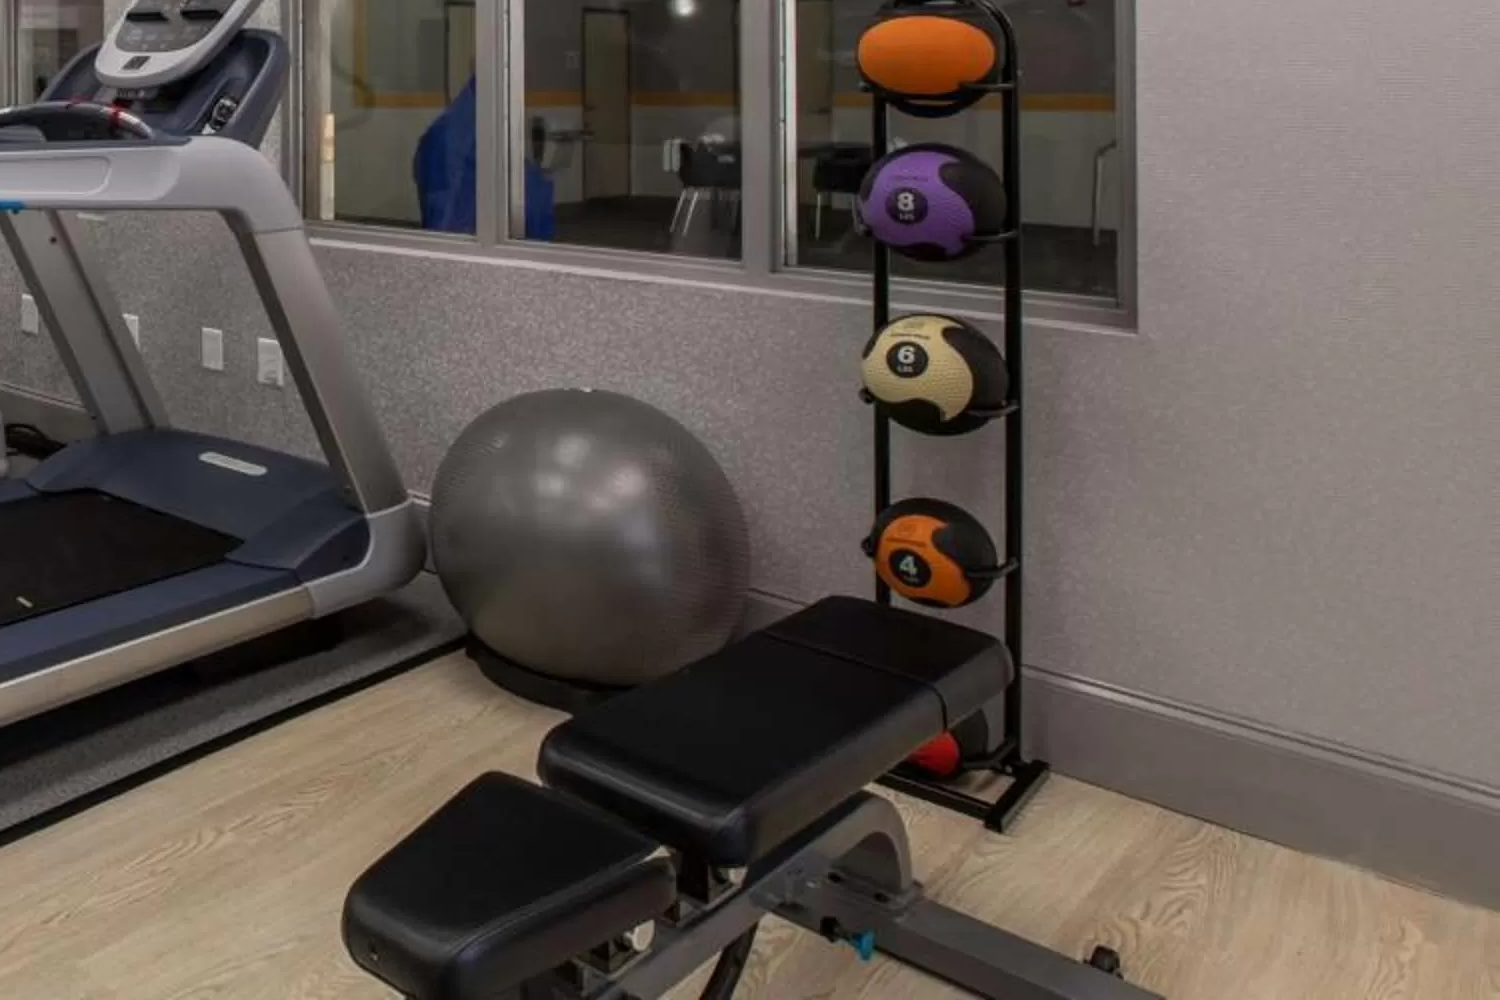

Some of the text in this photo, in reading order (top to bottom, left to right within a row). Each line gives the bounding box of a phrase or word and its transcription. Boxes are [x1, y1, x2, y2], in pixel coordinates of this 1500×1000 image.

[897, 192, 915, 211] 8
[898, 345, 915, 364] 6
[899, 555, 918, 575] 4
